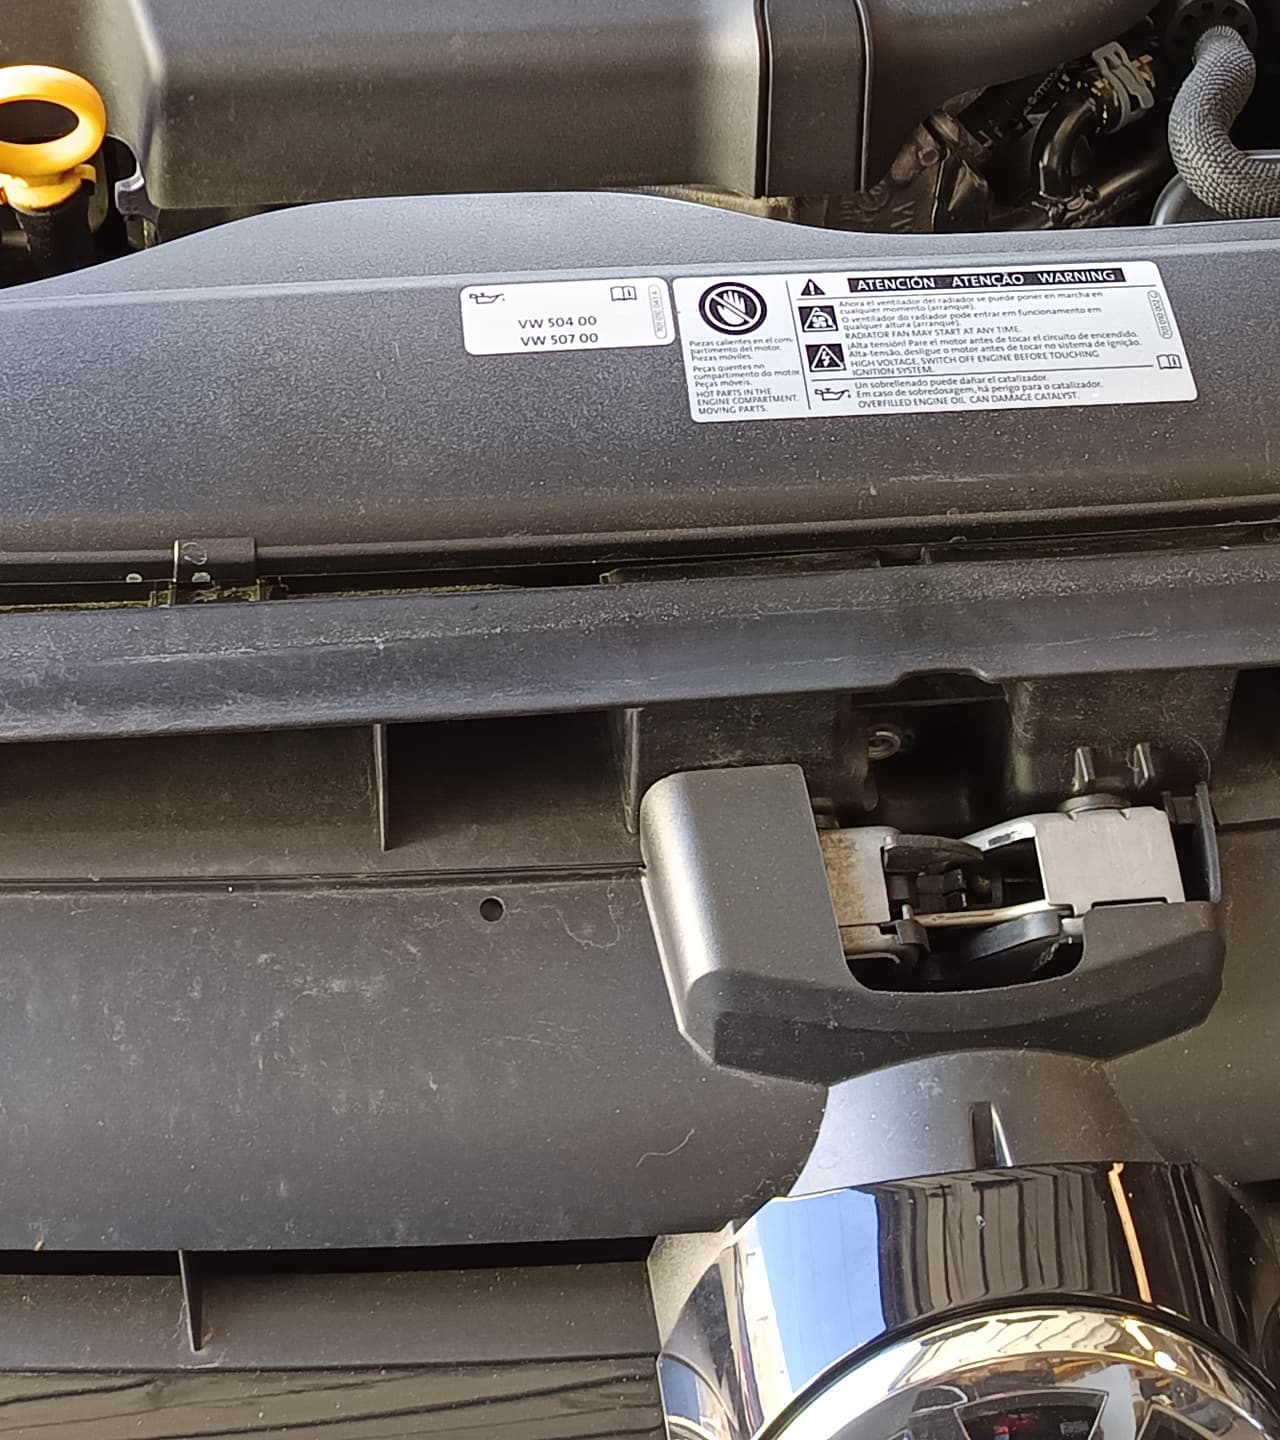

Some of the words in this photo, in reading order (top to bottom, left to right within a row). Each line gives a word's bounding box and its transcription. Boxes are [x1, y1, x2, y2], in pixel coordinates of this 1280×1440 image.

[857, 275, 936, 291] ATENCIÓN
[952, 272, 1025, 288] ATENÇÃO
[1037, 269, 1116, 284] WARNING
[876, 298, 921, 306] ventilador
[988, 294, 1015, 303] puede
[1018, 293, 1043, 302] poner
[1057, 291, 1090, 299] marcha
[839, 307, 881, 315] cualquier
[882, 305, 926, 313] momento
[841, 316, 849, 324] O
[851, 314, 895, 323] ventilador
[910, 312, 948, 321] radiador
[950, 312, 970, 321] pode
[1019, 307, 1086, 315] funcionamento
[518, 319, 544, 329] VW
[548, 317, 574, 328] 504
[578, 315, 597, 327] 00
[843, 322, 883, 331] qualquer
[520, 336, 547, 346] VW
[550, 334, 575, 345] 507
[579, 333, 599, 344] 00
[845, 331, 890, 340] RADIATOR
[891, 330, 910, 338] FAN
[912, 329, 933, 337] MAY
[996, 326, 1023, 334] TIME.
[715, 338, 752, 346] calientes
[870, 339, 907, 348] tensión!
[908, 339, 929, 347] Pare
[1043, 333, 1077, 341] circuito
[904, 347, 942, 357] desligue
[950, 346, 980, 354] motor
[981, 345, 1005, 353] antes
[1019, 343, 1043, 351] tocar
[1058, 341, 1093, 349] sistema
[692, 354, 717, 362] Piezas
[851, 360, 875, 368] HIGH
[921, 356, 957, 364] SWITCH
[959, 355, 975, 363] OFF
[977, 354, 1013, 362] ENGINE
[1014, 353, 1048, 361] BEFORE
[1049, 350, 1099, 359] TOUCHING
[693, 365, 717, 373] Peças
[718, 364, 752, 372] quentes
[852, 368, 895, 376] IGNITION
[897, 366, 935, 375] SYSTEM.
[693, 371, 760, 380] compartimento
[695, 381, 718, 390] Peças
[855, 381, 869, 389] Un
[870, 379, 928, 389] sobrellenado
[929, 378, 959, 388] puede
[961, 376, 986, 385] dañar
[987, 376, 996, 384] el
[696, 390, 714, 398] HOT
[716, 389, 741, 398] PARTS
[743, 388, 754, 396] IN
[755, 387, 772, 396] THE
[856, 390, 872, 398] Em
[894, 388, 907, 396] de
[978, 384, 990, 392] há
[991, 383, 1020, 394] perigo
[1021, 383, 1043, 392] para
[697, 398, 731, 407] ENGINE
[732, 394, 799, 405] COMPARTMENT.
[858, 399, 912, 409] OVERFILLED
[914, 397, 949, 407] ENGINE
[950, 396, 966, 405] OIL
[969, 395, 990, 404] CAN
[991, 393, 1033, 403] DAMAGE
[1034, 391, 1080, 401] CATALYST.
[698, 406, 736, 415] MOVING
[738, 404, 768, 414] PARTS.
